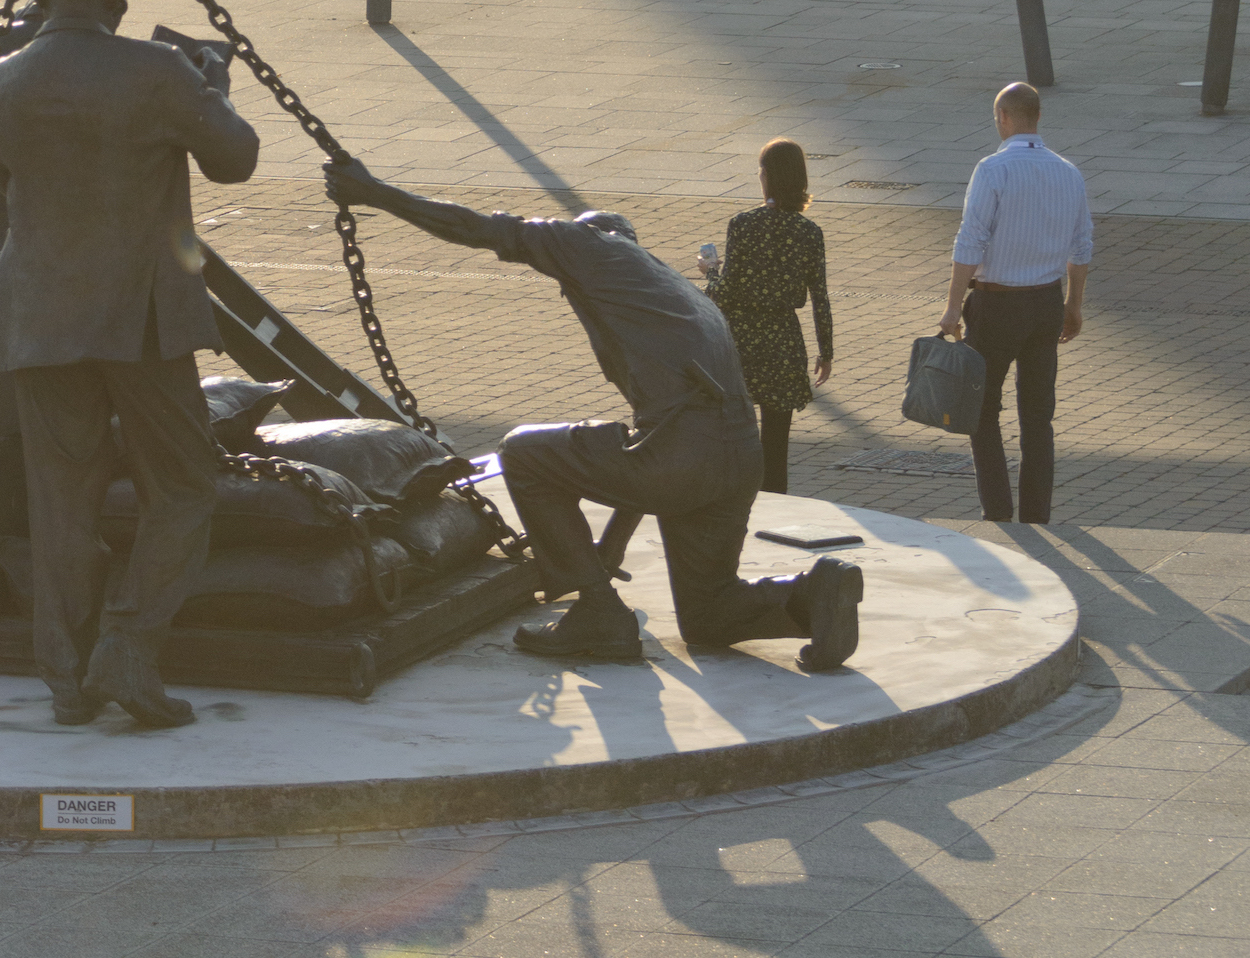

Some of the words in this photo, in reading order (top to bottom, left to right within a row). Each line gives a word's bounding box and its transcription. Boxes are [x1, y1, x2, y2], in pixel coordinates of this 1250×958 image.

[57, 800, 116, 812] DANGER
[57, 815, 70, 824] Do
[72, 816, 88, 824] Not
[90, 816, 116, 825] Climb
